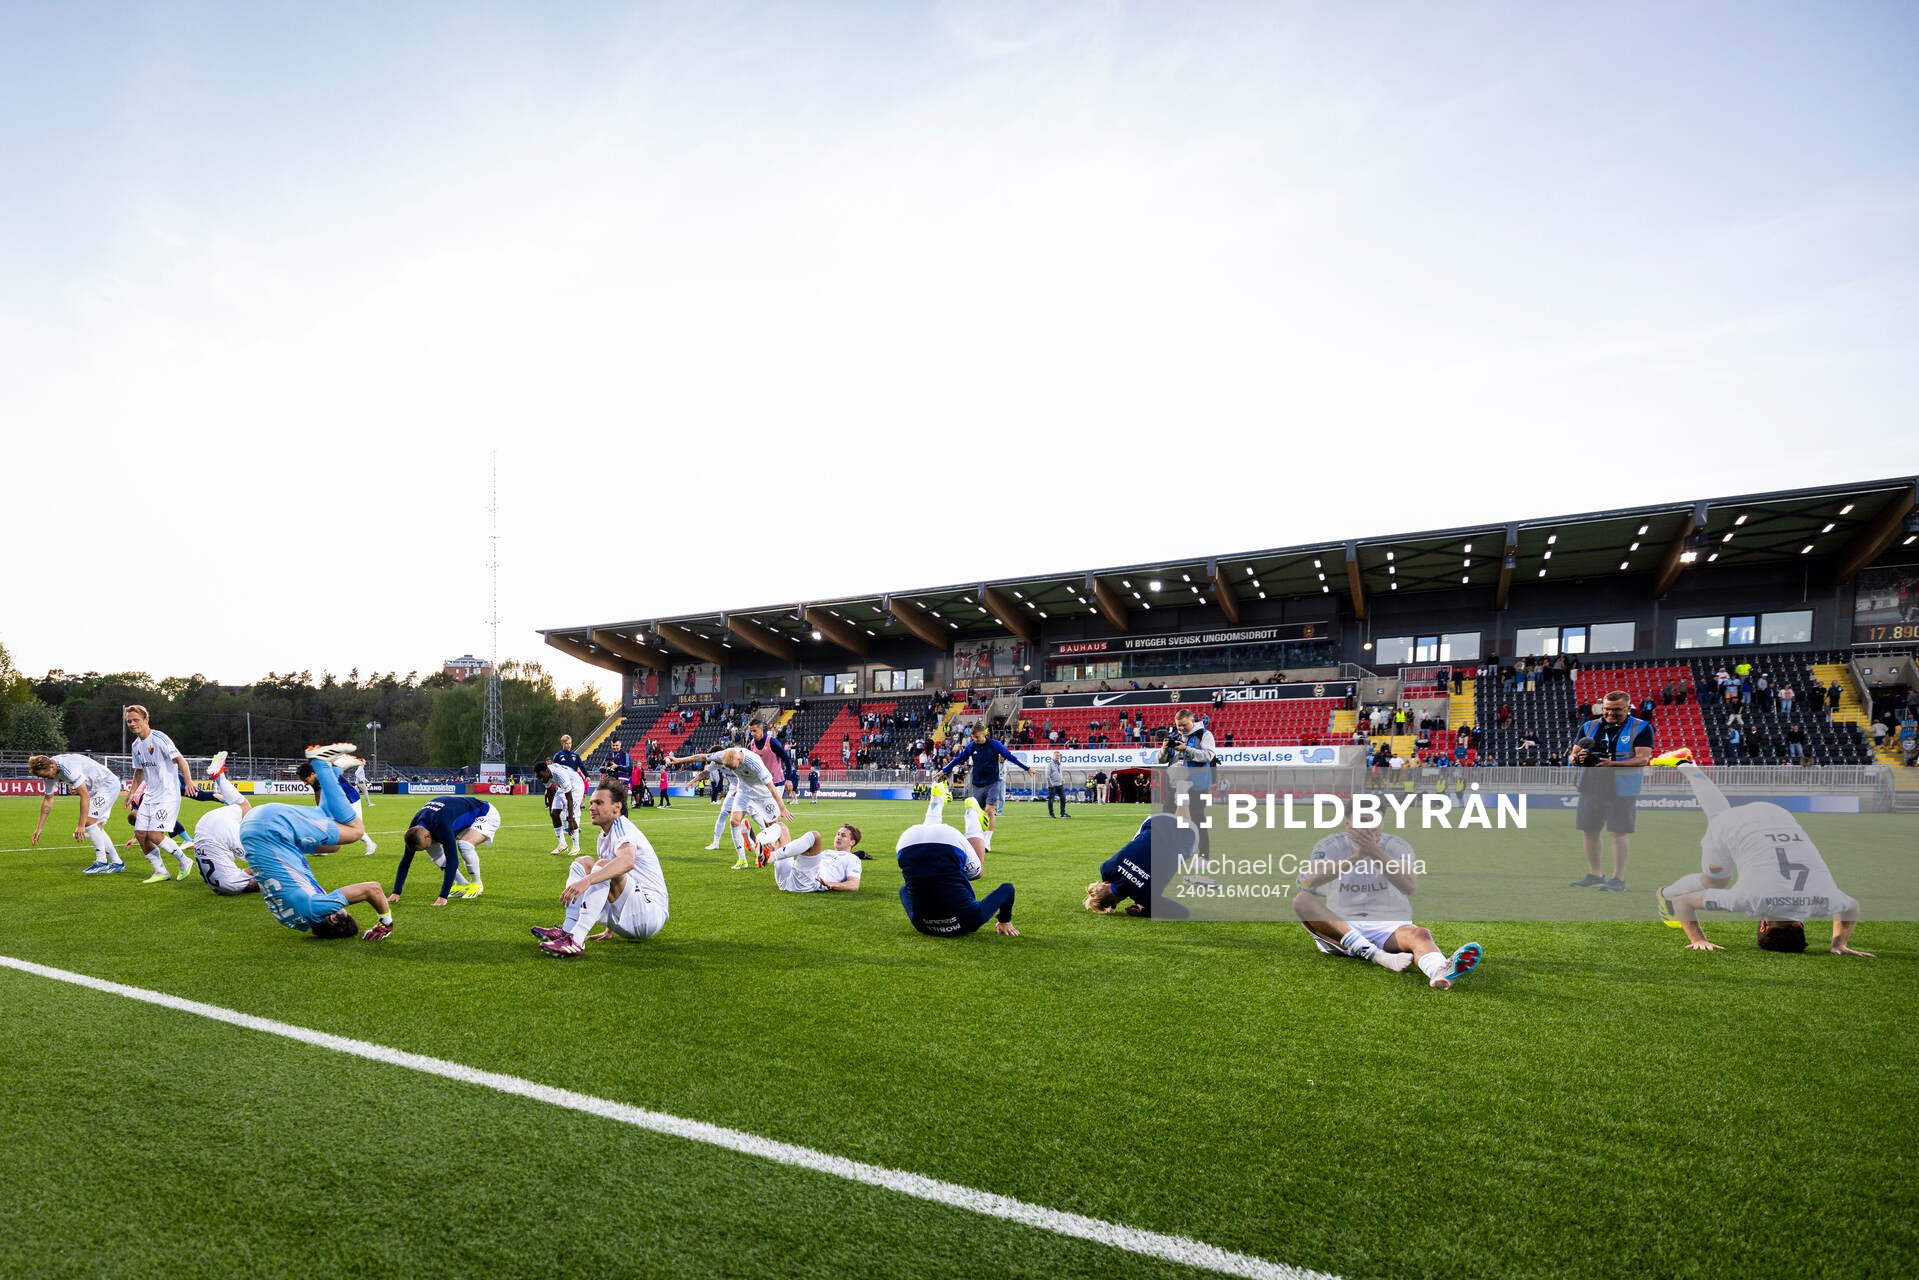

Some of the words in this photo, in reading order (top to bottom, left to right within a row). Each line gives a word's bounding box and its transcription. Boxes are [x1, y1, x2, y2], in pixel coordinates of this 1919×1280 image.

[1125, 640, 1133, 648] VI
[1135, 638, 1166, 648] BYGGER
[1168, 635, 1201, 645] SVENSK
[1203, 629, 1278, 643] UNGDOMSIDROTT
[1060, 642, 1108, 653] BAUHAUS
[1033, 752, 1132, 763] brebandsval.se
[1216, 751, 1292, 763] andsval.se
[0, 782, 57, 793] UHAU
[274, 783, 310, 792] TEKNOS
[489, 784, 511, 794] GARO
[1764, 833, 1804, 842] TCL
[1775, 848, 1810, 891] 4
[1117, 865, 1145, 888] MOBILL
[1339, 882, 1388, 893] MOBILL
